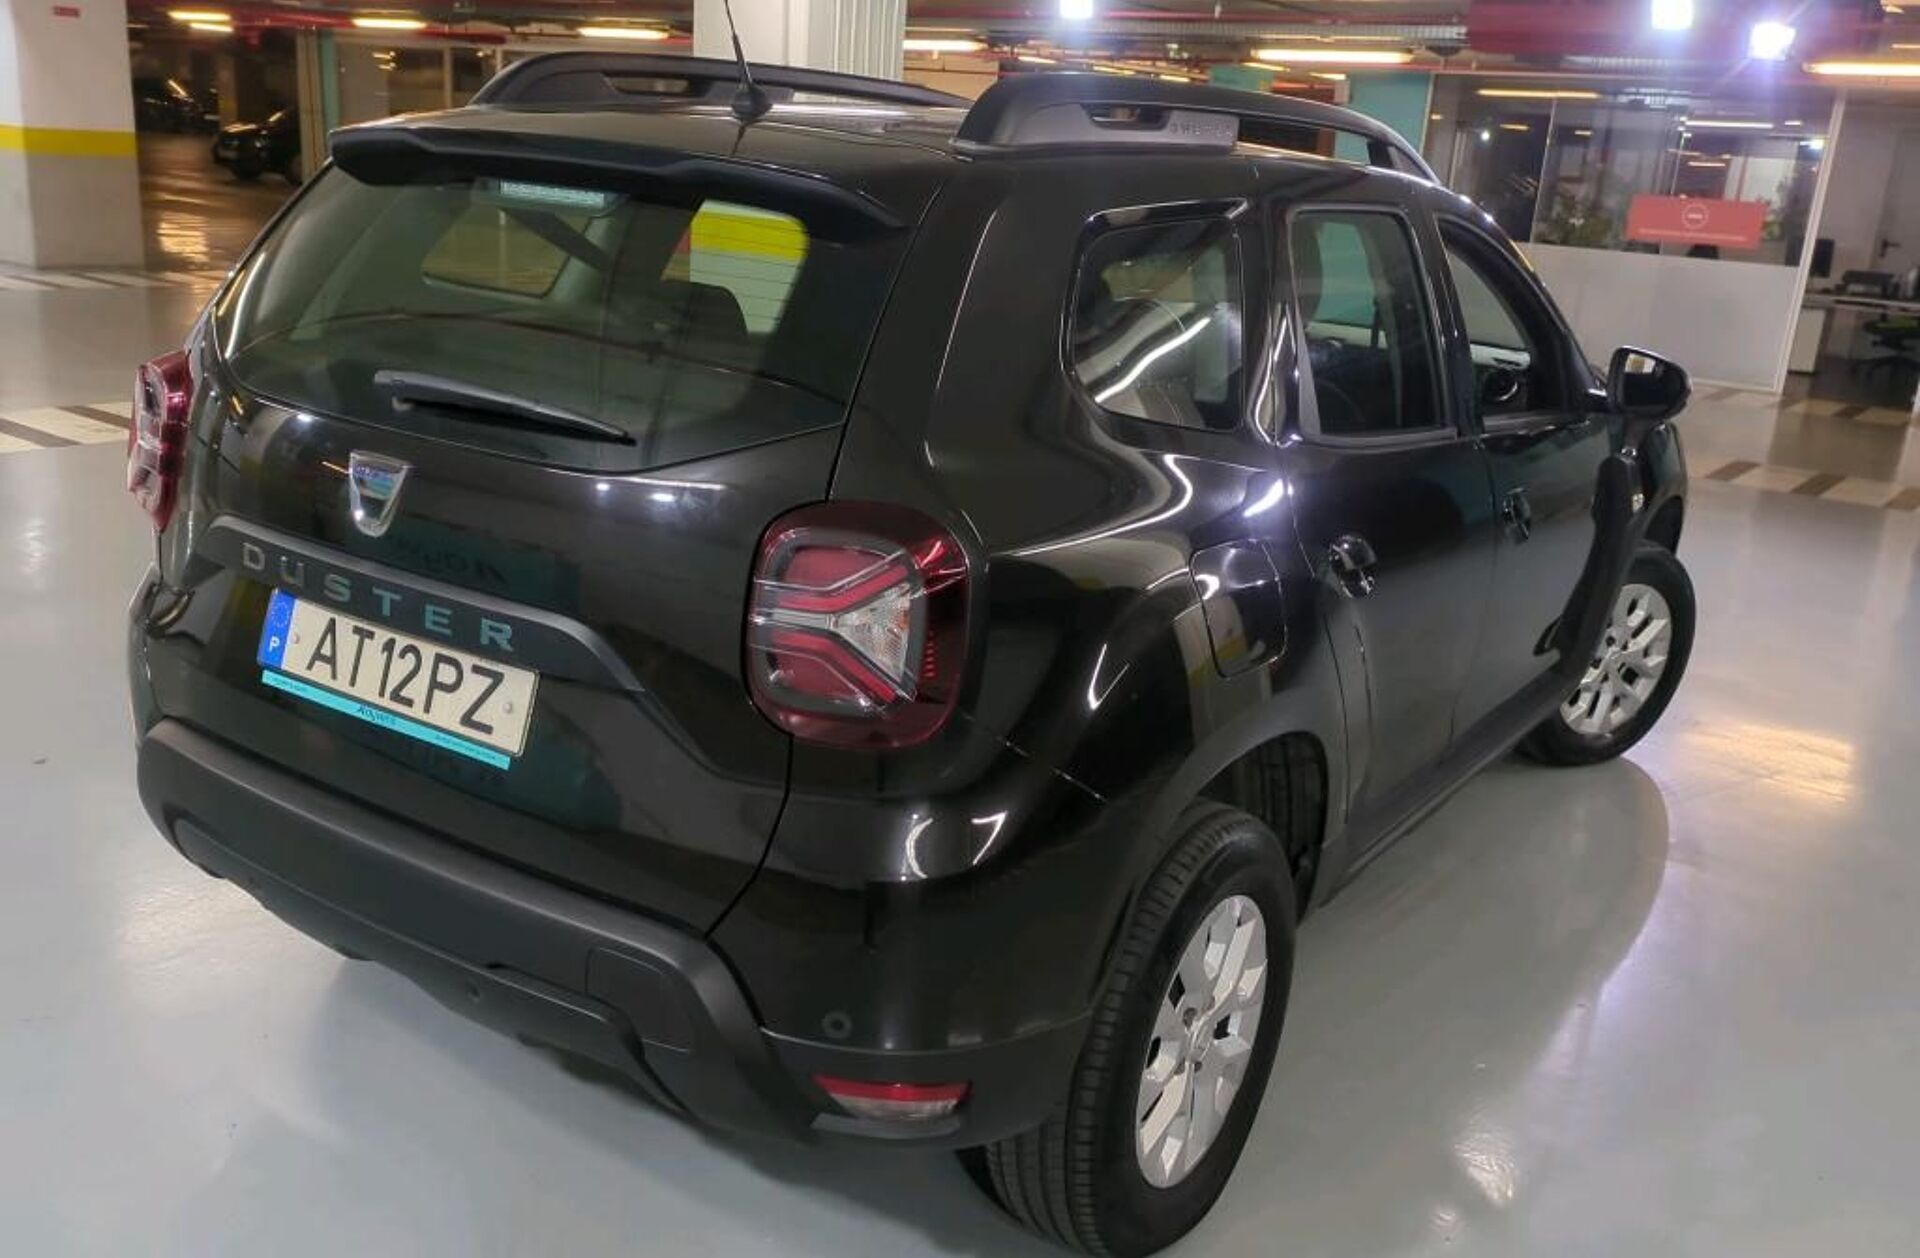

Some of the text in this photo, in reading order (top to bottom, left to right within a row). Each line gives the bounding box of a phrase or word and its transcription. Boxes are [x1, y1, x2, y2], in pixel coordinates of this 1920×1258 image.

[243, 542, 514, 652] DUSTER
[268, 637, 281, 652] P
[306, 617, 505, 735] AT12PZ
